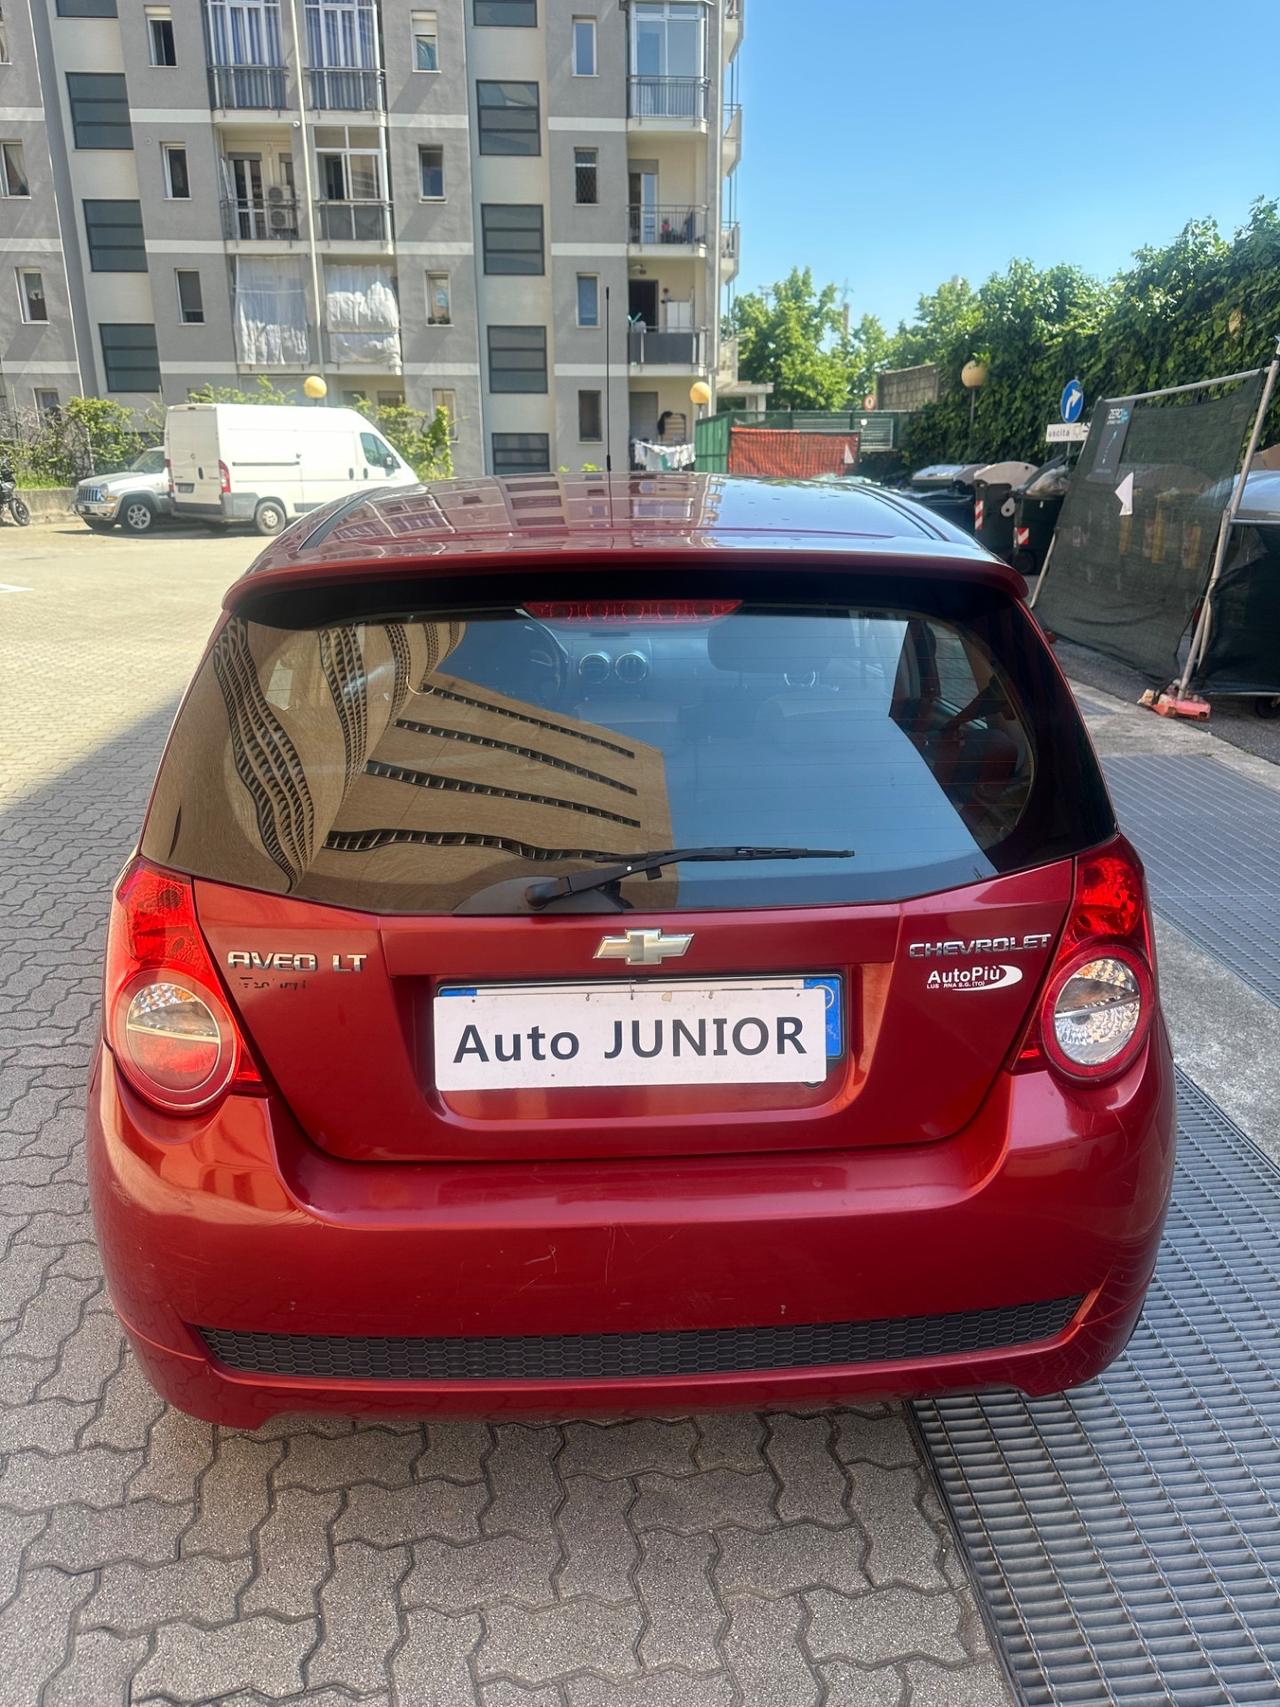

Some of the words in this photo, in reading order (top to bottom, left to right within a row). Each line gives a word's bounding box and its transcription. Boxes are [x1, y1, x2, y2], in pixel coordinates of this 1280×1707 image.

[909, 934, 1052, 958] CHEVROLET
[227, 951, 319, 972] AVEO
[332, 954, 368, 972] LT
[927, 965, 1000, 984] AutoPiù
[453, 1024, 580, 1064] Auto
[603, 1016, 808, 1059] JUNIOR
